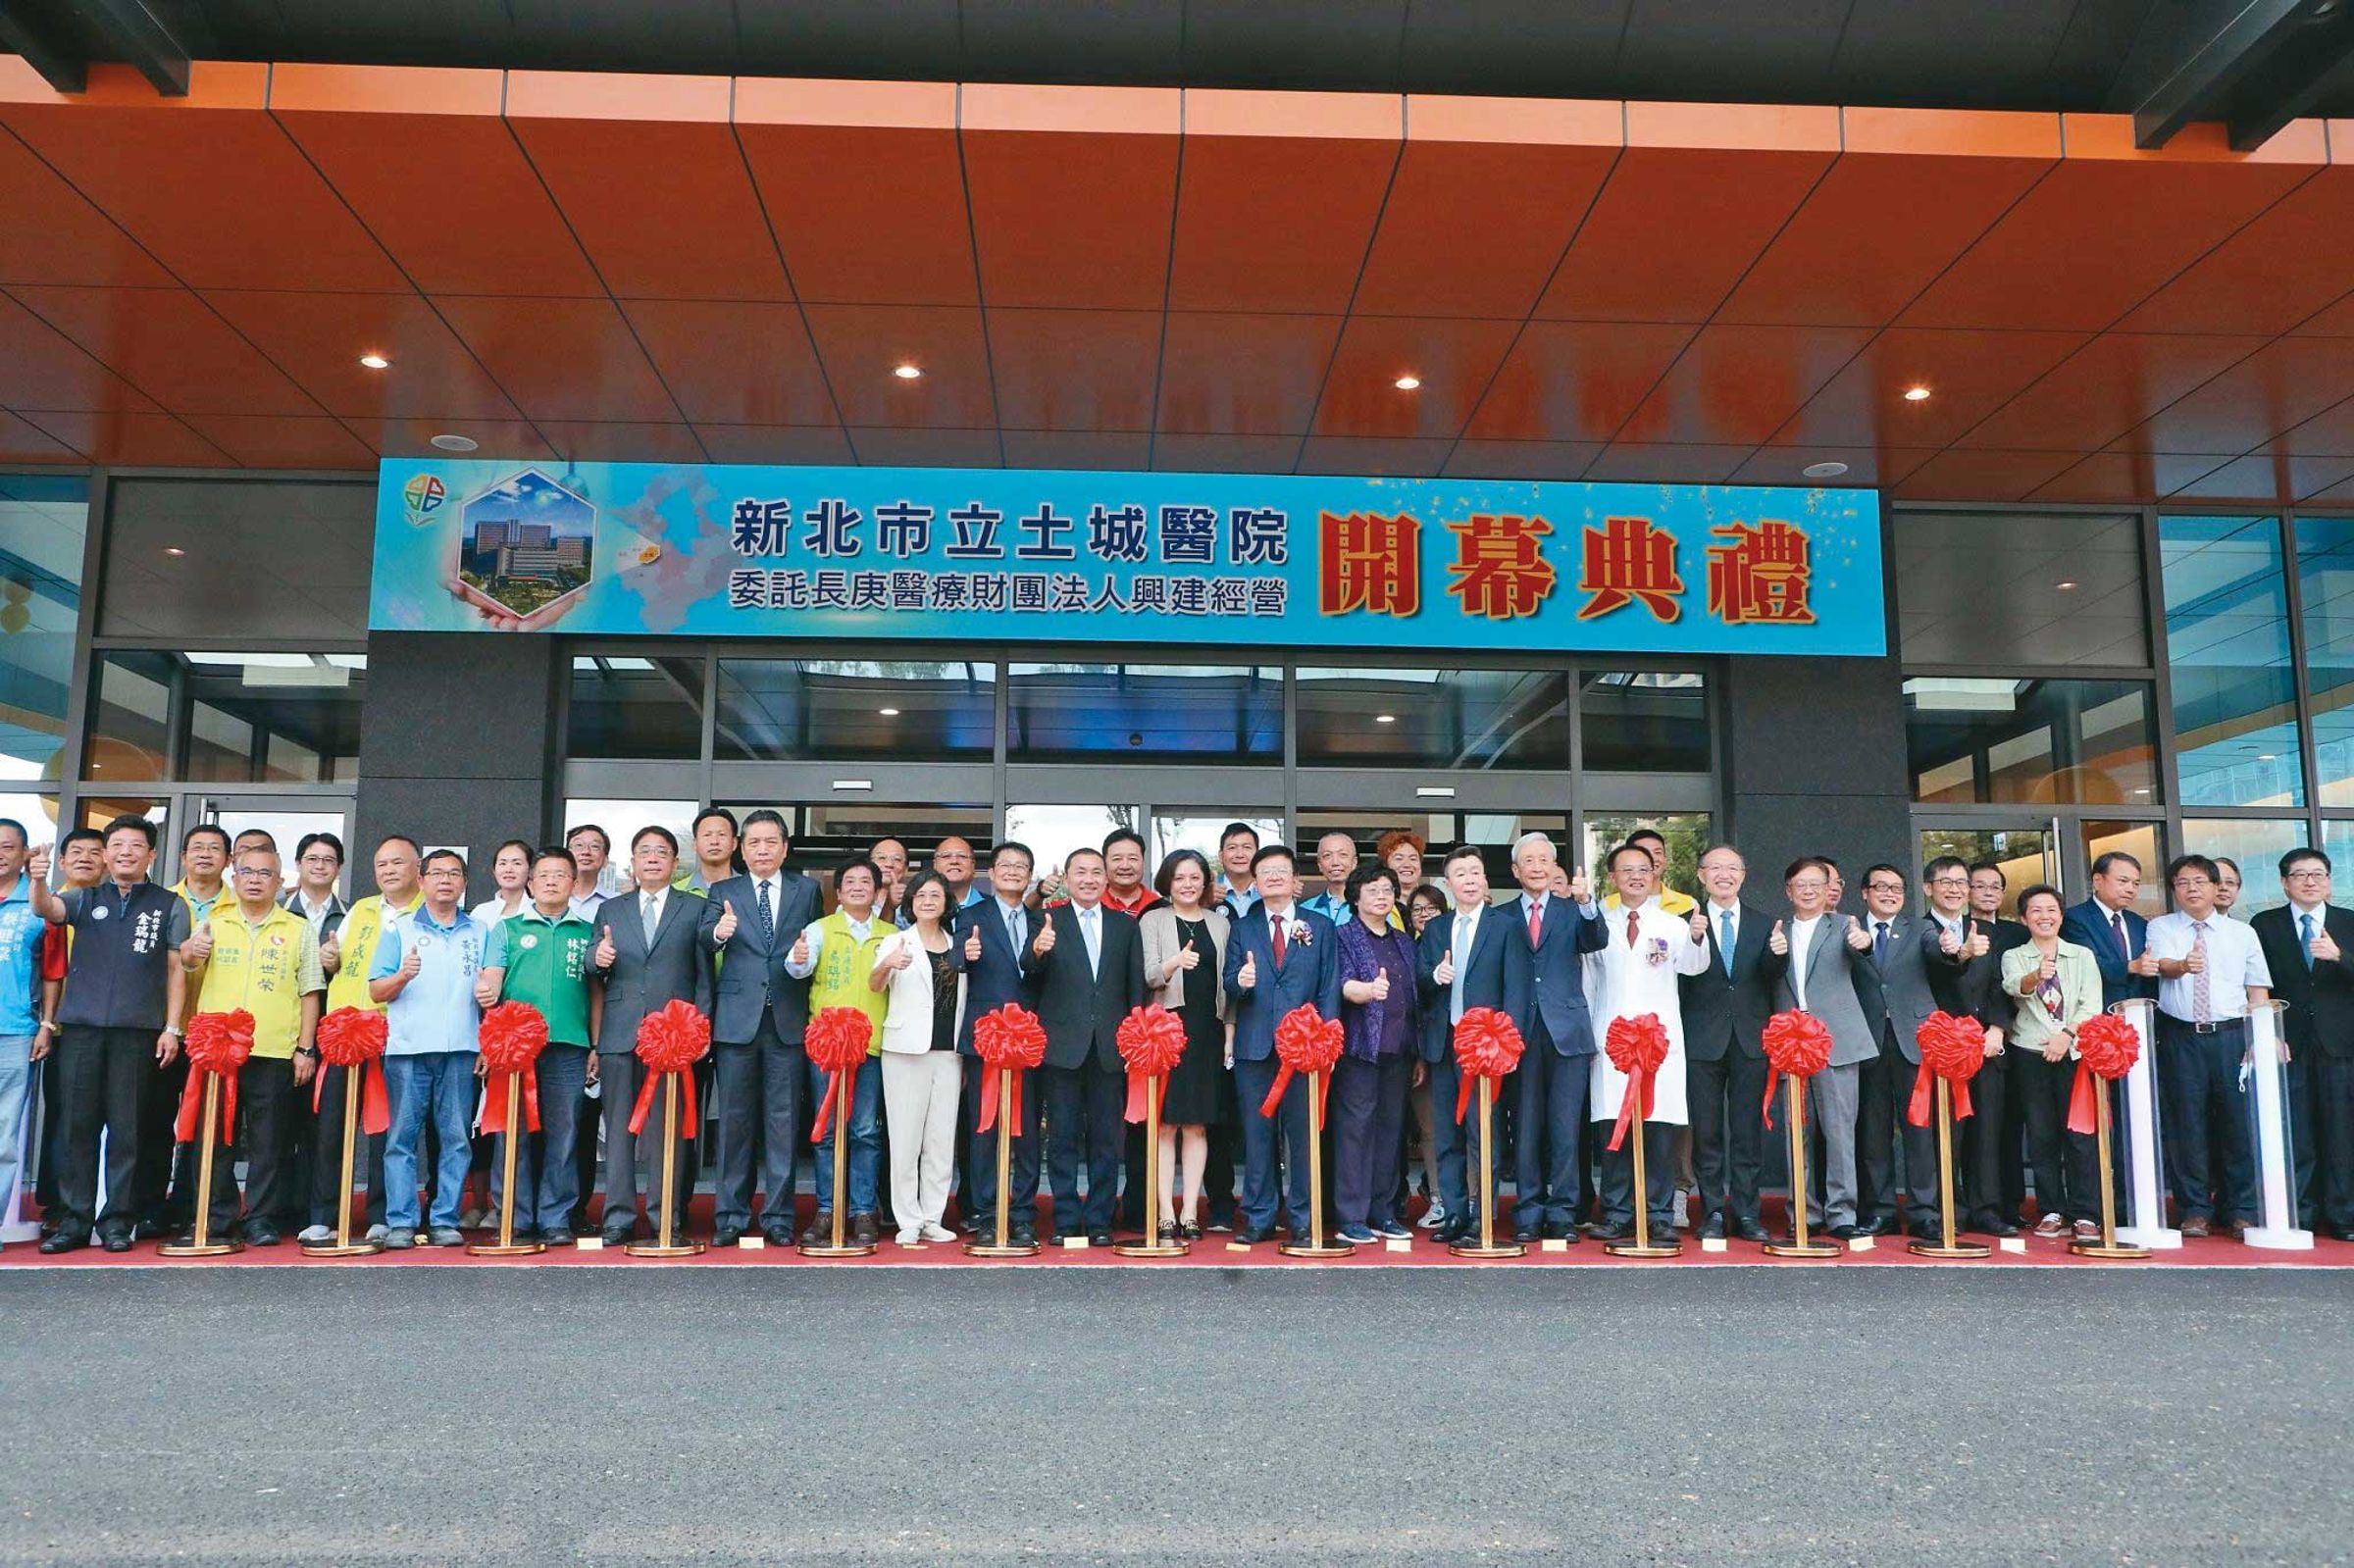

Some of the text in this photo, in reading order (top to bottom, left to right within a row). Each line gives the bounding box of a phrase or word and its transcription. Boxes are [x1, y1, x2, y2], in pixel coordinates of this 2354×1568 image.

[732, 498, 1287, 565] 新北市立土城醫院
[732, 569, 1286, 615] 委託長庚醫療財團法人興建經營
[1319, 511, 1817, 625] 開幕典禮
